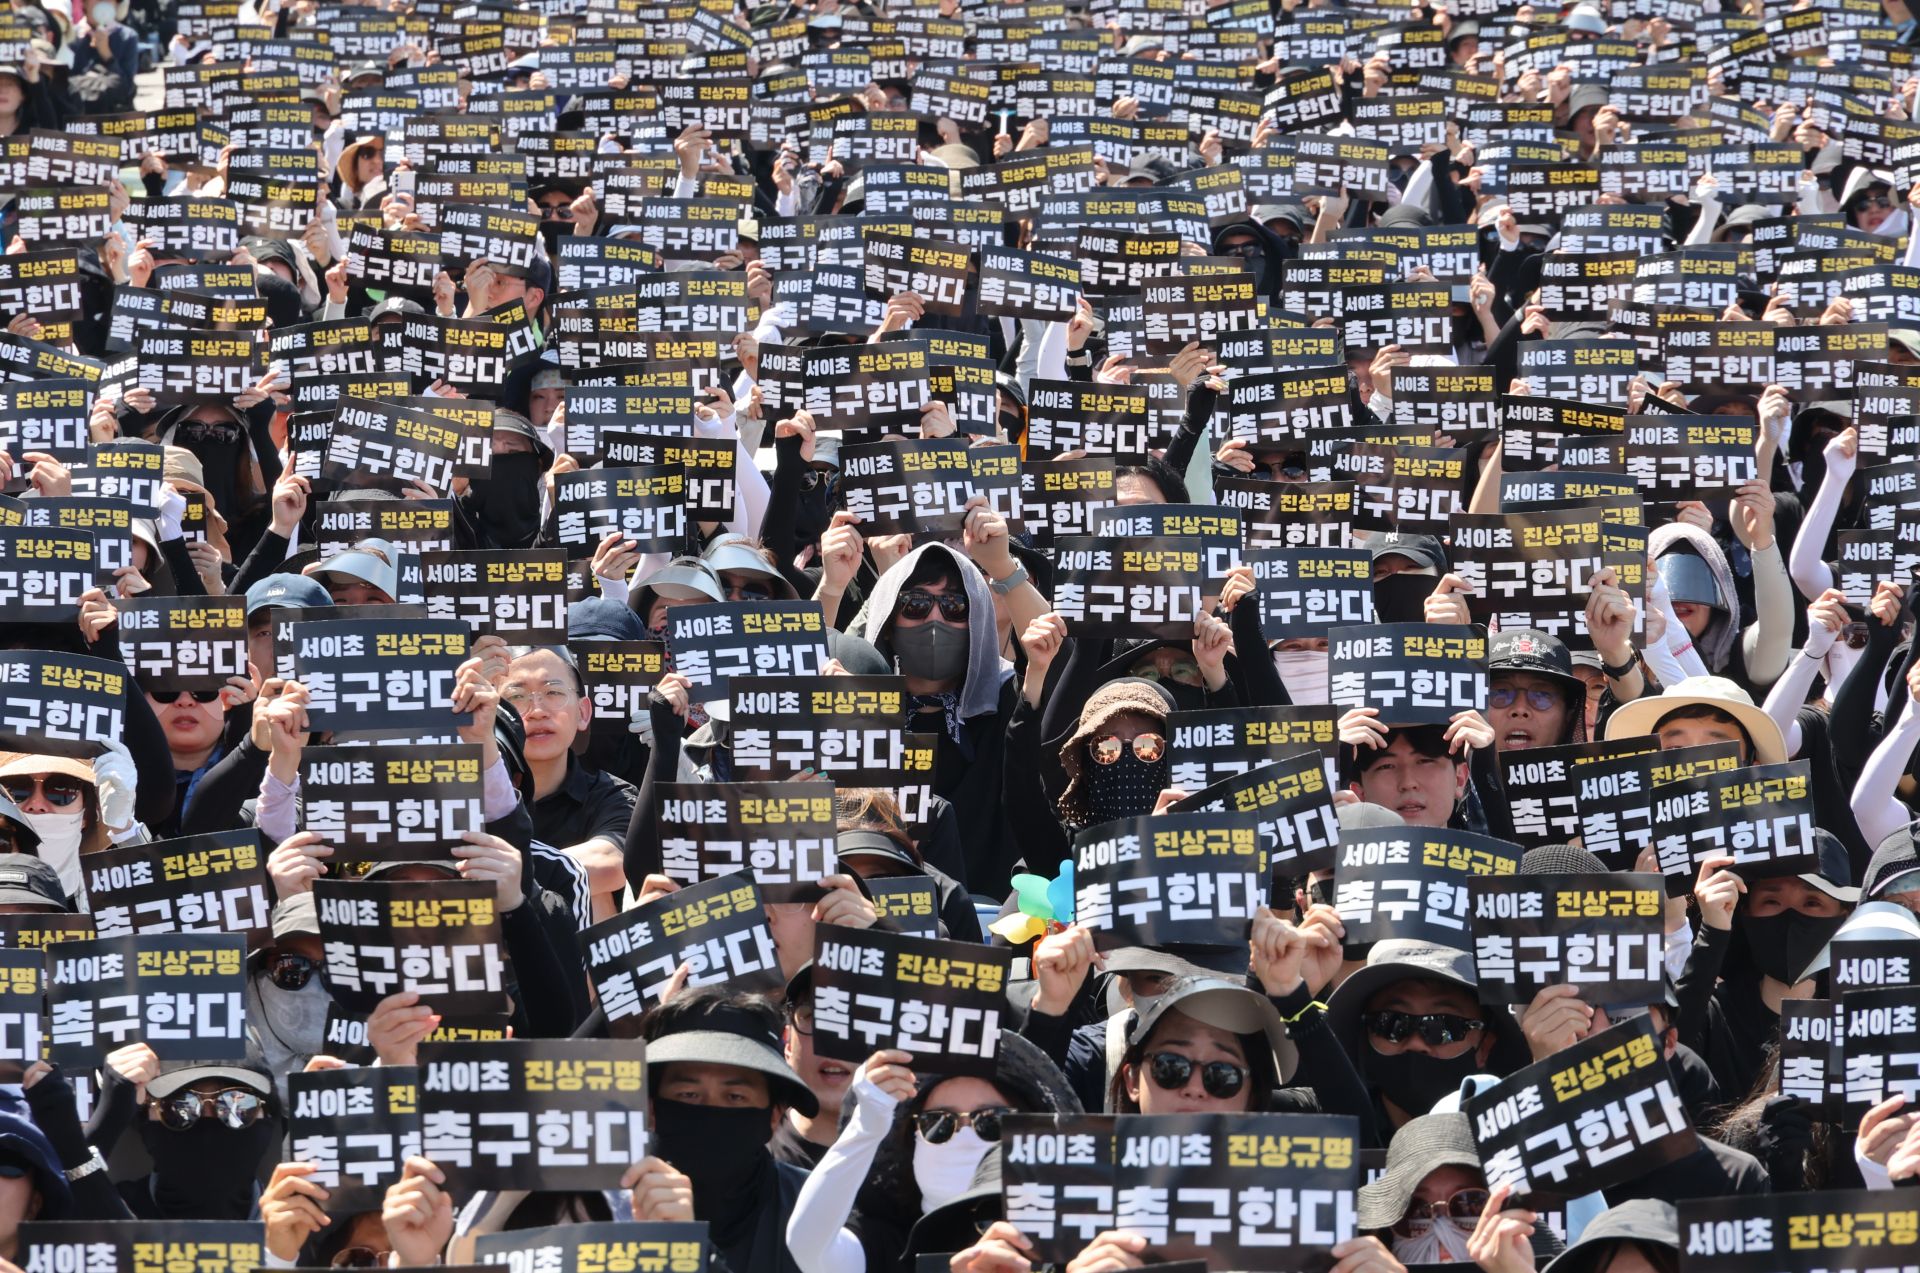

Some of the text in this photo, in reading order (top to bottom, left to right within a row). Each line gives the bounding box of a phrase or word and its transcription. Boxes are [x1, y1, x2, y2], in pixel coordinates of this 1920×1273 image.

[664, 86, 748, 100] 서이초 진상규명
[231, 109, 314, 123] 서이초 진상규명
[665, 105, 750, 130] 촉구한다
[1356, 102, 1443, 117] 서이초 진상규명
[835, 118, 917, 131] 서이초 진상규명
[1356, 121, 1446, 146] 촉구한다
[32, 137, 120, 158] 서이초 진상규명
[230, 128, 312, 150] 촉구한다
[832, 137, 920, 159] 촉구한다
[1298, 141, 1387, 160] 서이초 진상규명
[1602, 151, 1687, 164] 서이초 진상규명
[1713, 150, 1801, 164] 서이초 진상규명
[1295, 162, 1388, 192] 촉구한다
[1601, 170, 1690, 194] 촉구한다
[1713, 170, 1800, 194] 촉구한다
[147, 204, 236, 220] 서이초 진상규명
[645, 206, 736, 220] 서이초 진상규명
[1043, 201, 1136, 215] 서이초 진상규명
[146, 225, 238, 250] 촉구한다
[352, 231, 439, 255] 서이초 진상규명
[643, 226, 738, 253] 촉구한다
[867, 241, 967, 270] 서이초 진상규명
[984, 255, 1079, 283] 서이초 진상규명
[639, 281, 745, 298] 서이초 진상규명
[1346, 292, 1449, 311] 서이초 진상규명
[638, 304, 746, 332] 촉구한다
[405, 322, 504, 348] 서이초 진상규명
[1345, 317, 1452, 348] 촉구한다
[1668, 330, 1774, 346] 서이초 진상규명
[141, 339, 250, 357] 서이초 진상규명
[1220, 339, 1334, 358] 서이초 진상규명
[402, 348, 505, 384] 촉구한다
[806, 352, 924, 376] 서이초 진상규명
[139, 364, 250, 393] 촉구한다
[1233, 377, 1345, 404] 서이초 진상규명
[16, 390, 84, 409] 진상규명
[804, 378, 931, 418] 촉구한다
[1032, 391, 1145, 414] 서이초 진상규명
[339, 407, 459, 448] 서이초 진상규명
[1029, 418, 1148, 454] 촉구한다
[1232, 402, 1353, 444] 촉구한다
[1629, 427, 1752, 445] 서이초 진상규명
[845, 452, 968, 476] 서이초 진상규명
[1334, 454, 1462, 478] 서이초 진상규명
[1627, 455, 1758, 488] 촉구한다
[559, 475, 683, 501] 서이초 진상규명
[1221, 490, 1350, 512] 서이초 진상규명
[1455, 523, 1598, 548] 서이초 진상규명
[427, 562, 563, 583] 서이초 진상규명
[1058, 551, 1198, 573] 서이초 진상규명
[1299, 560, 1369, 578] 진상규명
[1053, 583, 1202, 624] 촉구한다
[171, 608, 244, 628] 진상규명
[675, 613, 820, 639] 서이초 진상규명
[299, 634, 465, 658] 서이초 진상규명
[1334, 637, 1392, 660] 서이초
[1405, 637, 1485, 659] 진상규명
[675, 645, 829, 685] 촉구한다
[42, 665, 123, 695] 진상규명
[1331, 668, 1489, 710] 촉구한다
[735, 691, 900, 714] 서이초 진상규명
[1173, 720, 1333, 748] 서이초 진상규명
[734, 729, 904, 770] 촉구한다
[307, 760, 479, 785] 서이초 진상규명
[1508, 761, 1566, 785] 서이초
[1581, 771, 1641, 800] 서이초
[1234, 768, 1324, 812] 진상규명
[1656, 776, 1806, 823] 서이초 진상규명
[306, 800, 484, 844] 촉구한다
[662, 798, 831, 823] 서이초 진상규명
[1078, 829, 1254, 871] 서이초 진상규명
[1342, 841, 1517, 876] 서이초 진상규명
[1657, 813, 1816, 876] 촉구한다
[91, 846, 256, 892] 서이초 진상규명
[661, 838, 837, 885] 촉구한다
[95, 884, 270, 935] 촉구한다
[321, 899, 494, 927] 서이초 진상규명
[1076, 872, 1260, 929] 촉구한다
[1476, 891, 1658, 919] 서이초 진상규명
[590, 885, 758, 968] 서이초 진상규명
[53, 950, 240, 984] 서이초 진상규명
[326, 942, 504, 995] 촉구한다
[818, 942, 1002, 991] 서이초 진상규명
[1476, 934, 1665, 983] 촉구한다
[52, 992, 245, 1046] 촉구한다
[814, 986, 1001, 1059] 촉구한다
[1848, 1006, 1916, 1037] 서이초
[425, 1061, 640, 1092] 서이초 진상규명
[1478, 1034, 1657, 1143] 서이초 진상규명
[295, 1087, 374, 1118] 서이초
[424, 1111, 649, 1168] 촉구한다
[1008, 1134, 1095, 1164] 서이초
[1122, 1134, 1352, 1168] 서이초 진상규명
[1484, 1080, 1688, 1195] 촉구한다
[1117, 1185, 1358, 1246] 촉구한다
[1687, 1211, 1918, 1255] 서이초 진상규명
[26, 1243, 259, 1273] 서이초 진상규명
[578, 1243, 699, 1273] 진상규명
